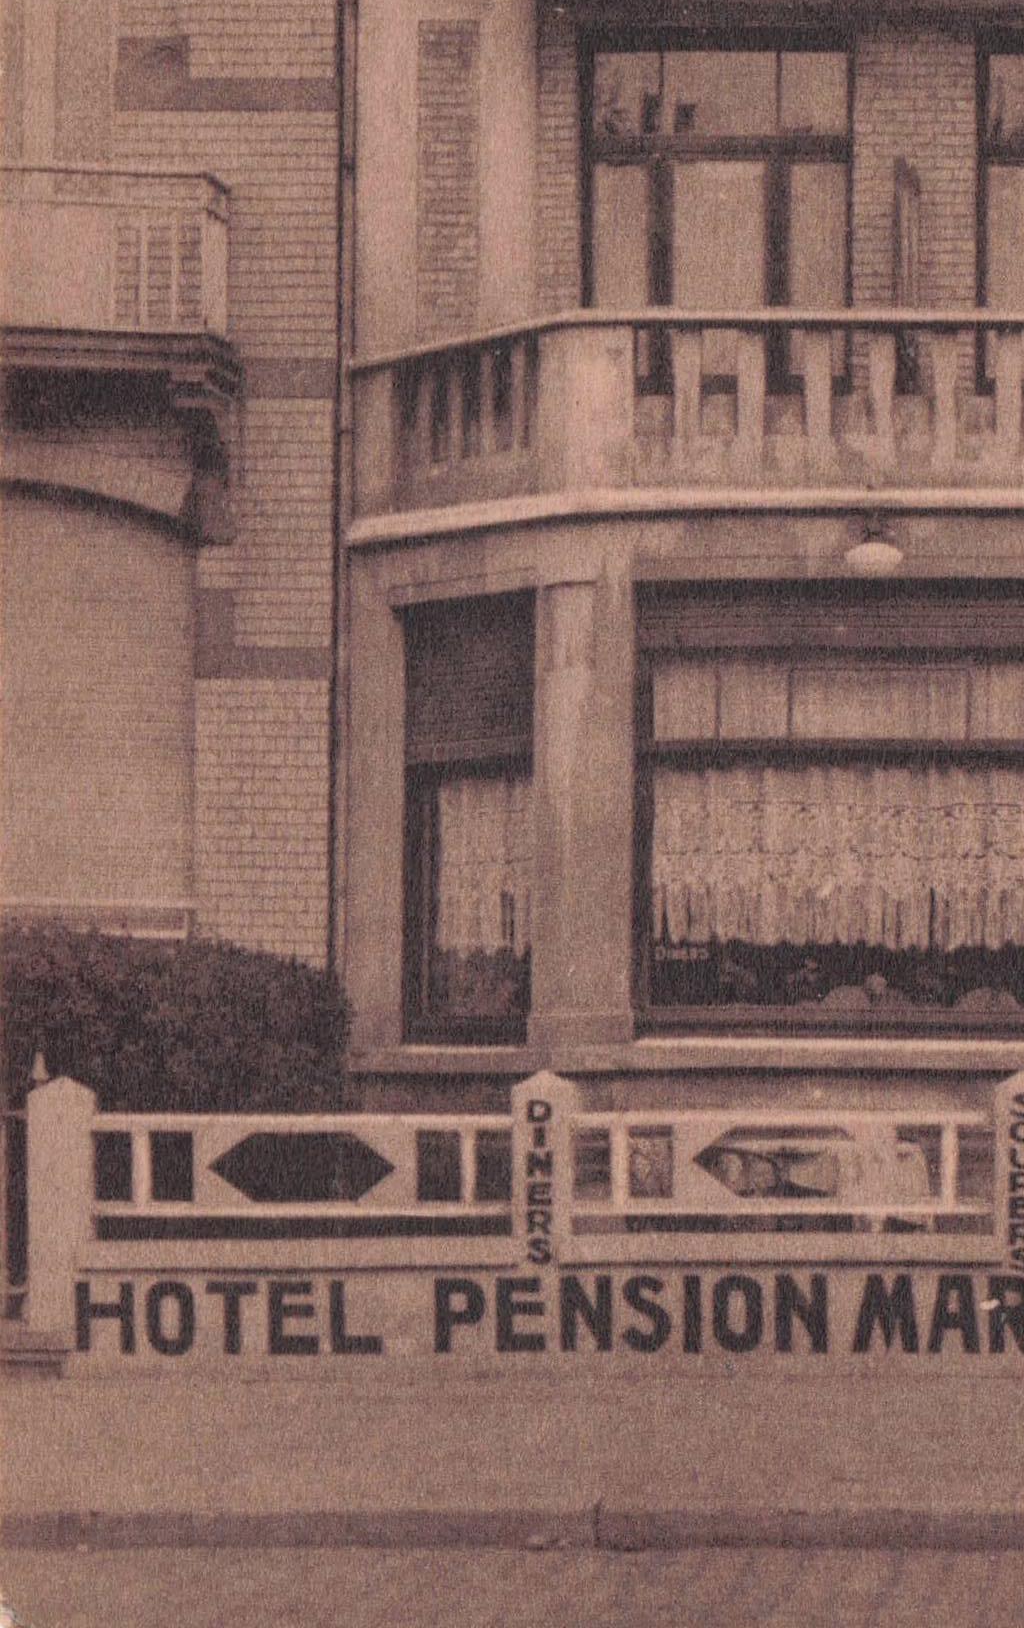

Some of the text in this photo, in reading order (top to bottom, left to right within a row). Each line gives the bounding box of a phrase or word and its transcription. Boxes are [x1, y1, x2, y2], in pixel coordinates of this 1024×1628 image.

[526, 1100, 553, 1266] DINERS
[75, 1280, 383, 1355] HOTEL
[433, 1274, 828, 1355] PENSION
